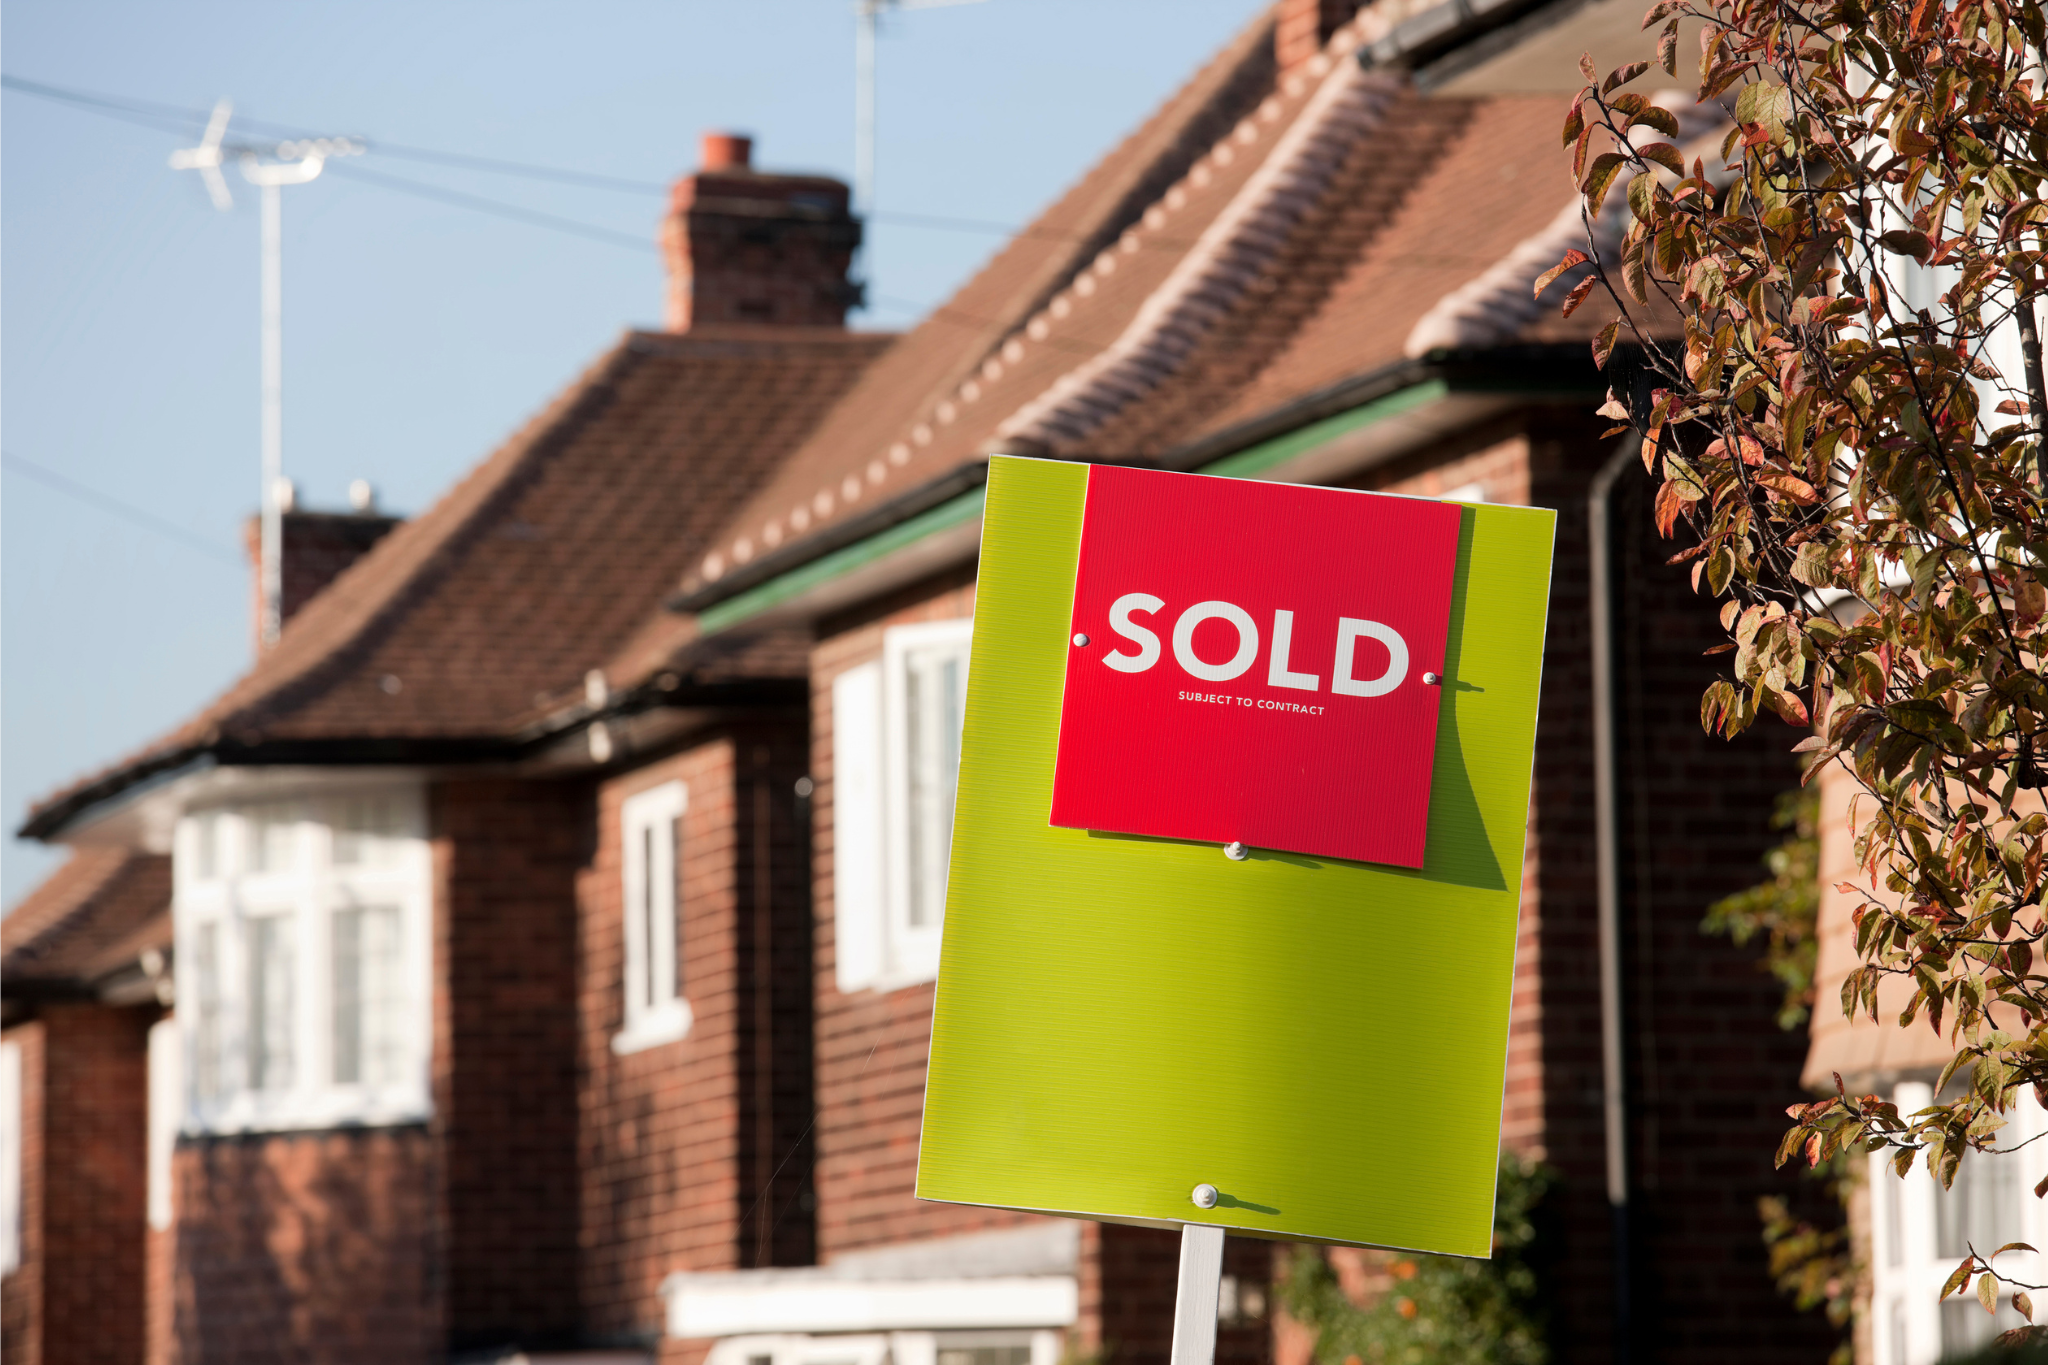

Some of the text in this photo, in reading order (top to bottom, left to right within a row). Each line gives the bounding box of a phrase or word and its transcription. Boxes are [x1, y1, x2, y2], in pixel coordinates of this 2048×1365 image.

[1101, 592, 1410, 698] SOLD
[1178, 690, 1325, 716] SUBJECT TO CONTRACT
